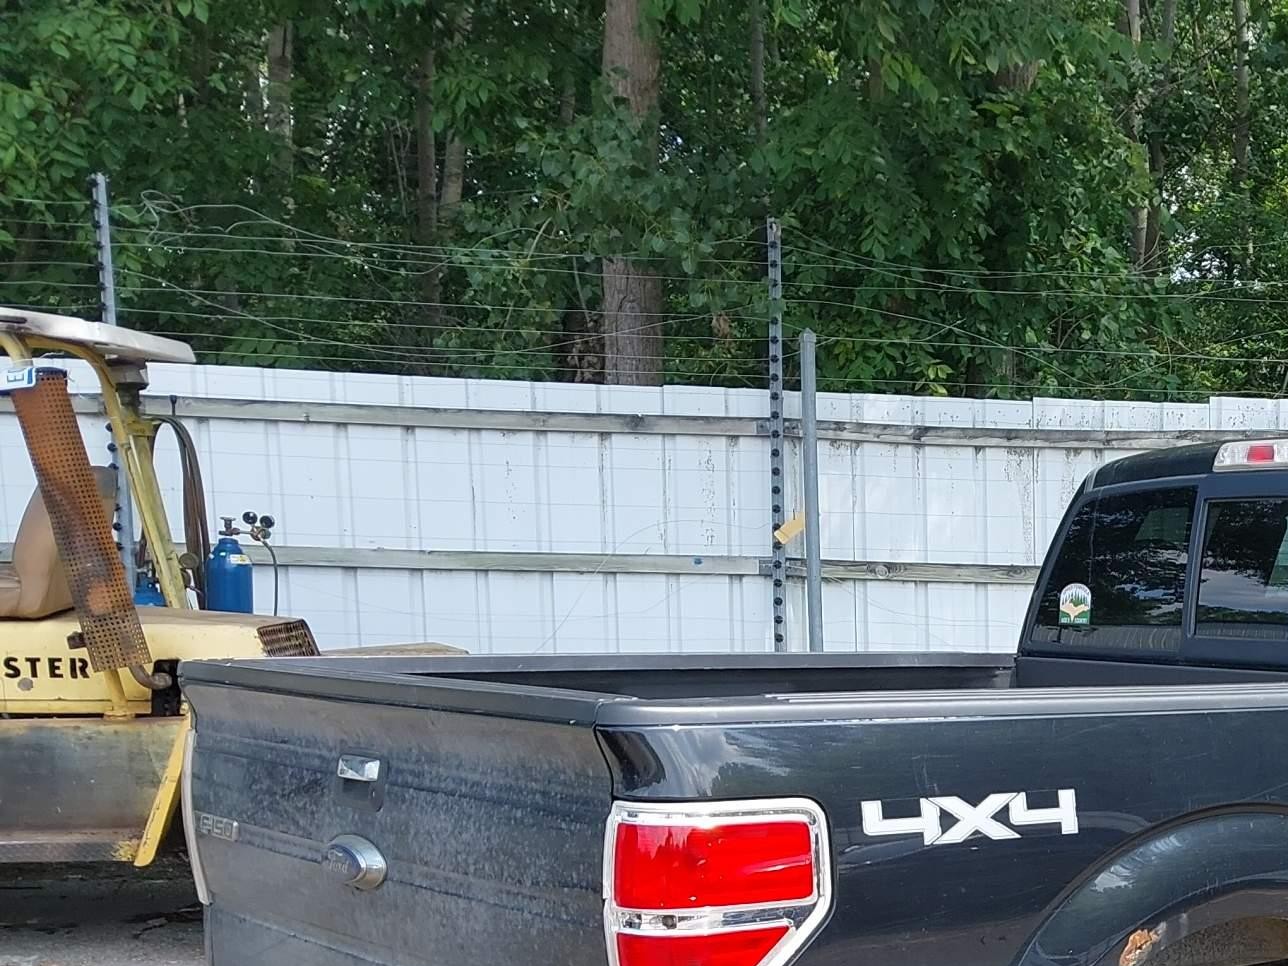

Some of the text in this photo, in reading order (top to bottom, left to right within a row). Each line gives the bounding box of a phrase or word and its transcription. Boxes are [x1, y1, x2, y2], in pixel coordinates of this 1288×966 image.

[4, 657, 90, 680] STER
[861, 788, 1079, 846] 4X4
[327, 848, 350, 873] Ford
